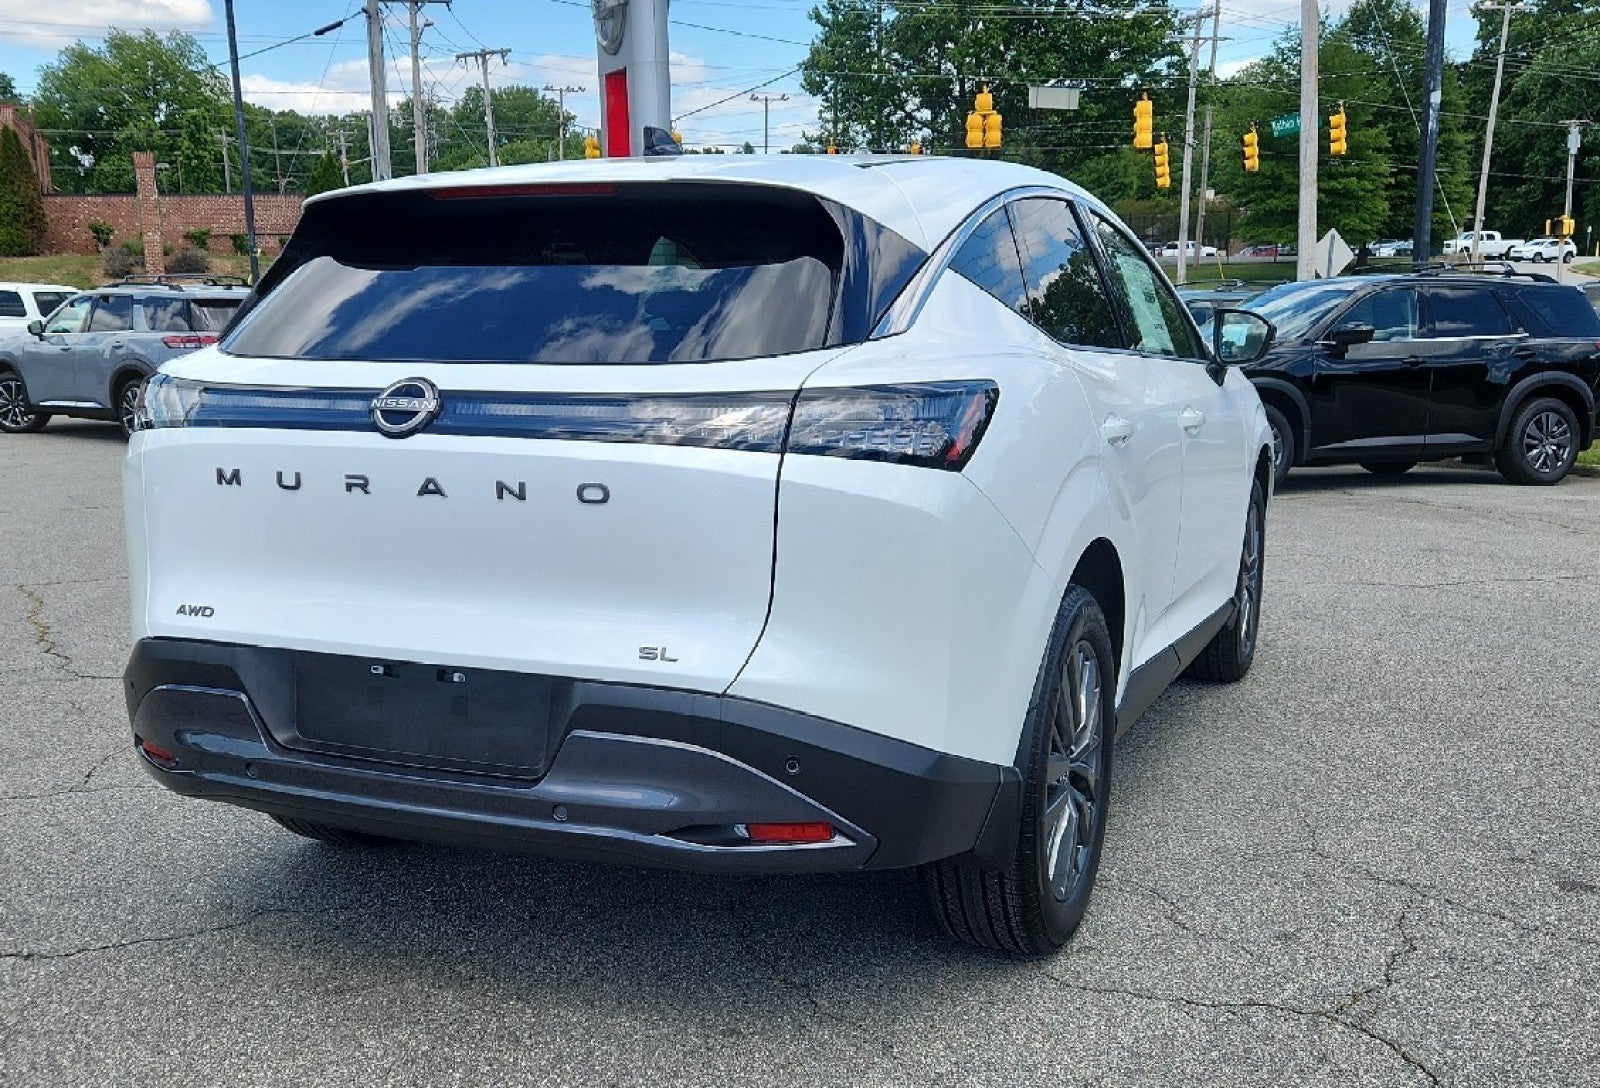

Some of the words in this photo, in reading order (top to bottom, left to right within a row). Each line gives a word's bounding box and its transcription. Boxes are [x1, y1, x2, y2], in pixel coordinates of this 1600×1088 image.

[371, 398, 434, 410] NISSAN
[216, 466, 611, 505] MURANO
[176, 604, 215, 618] AWD
[638, 646, 679, 663] SL
